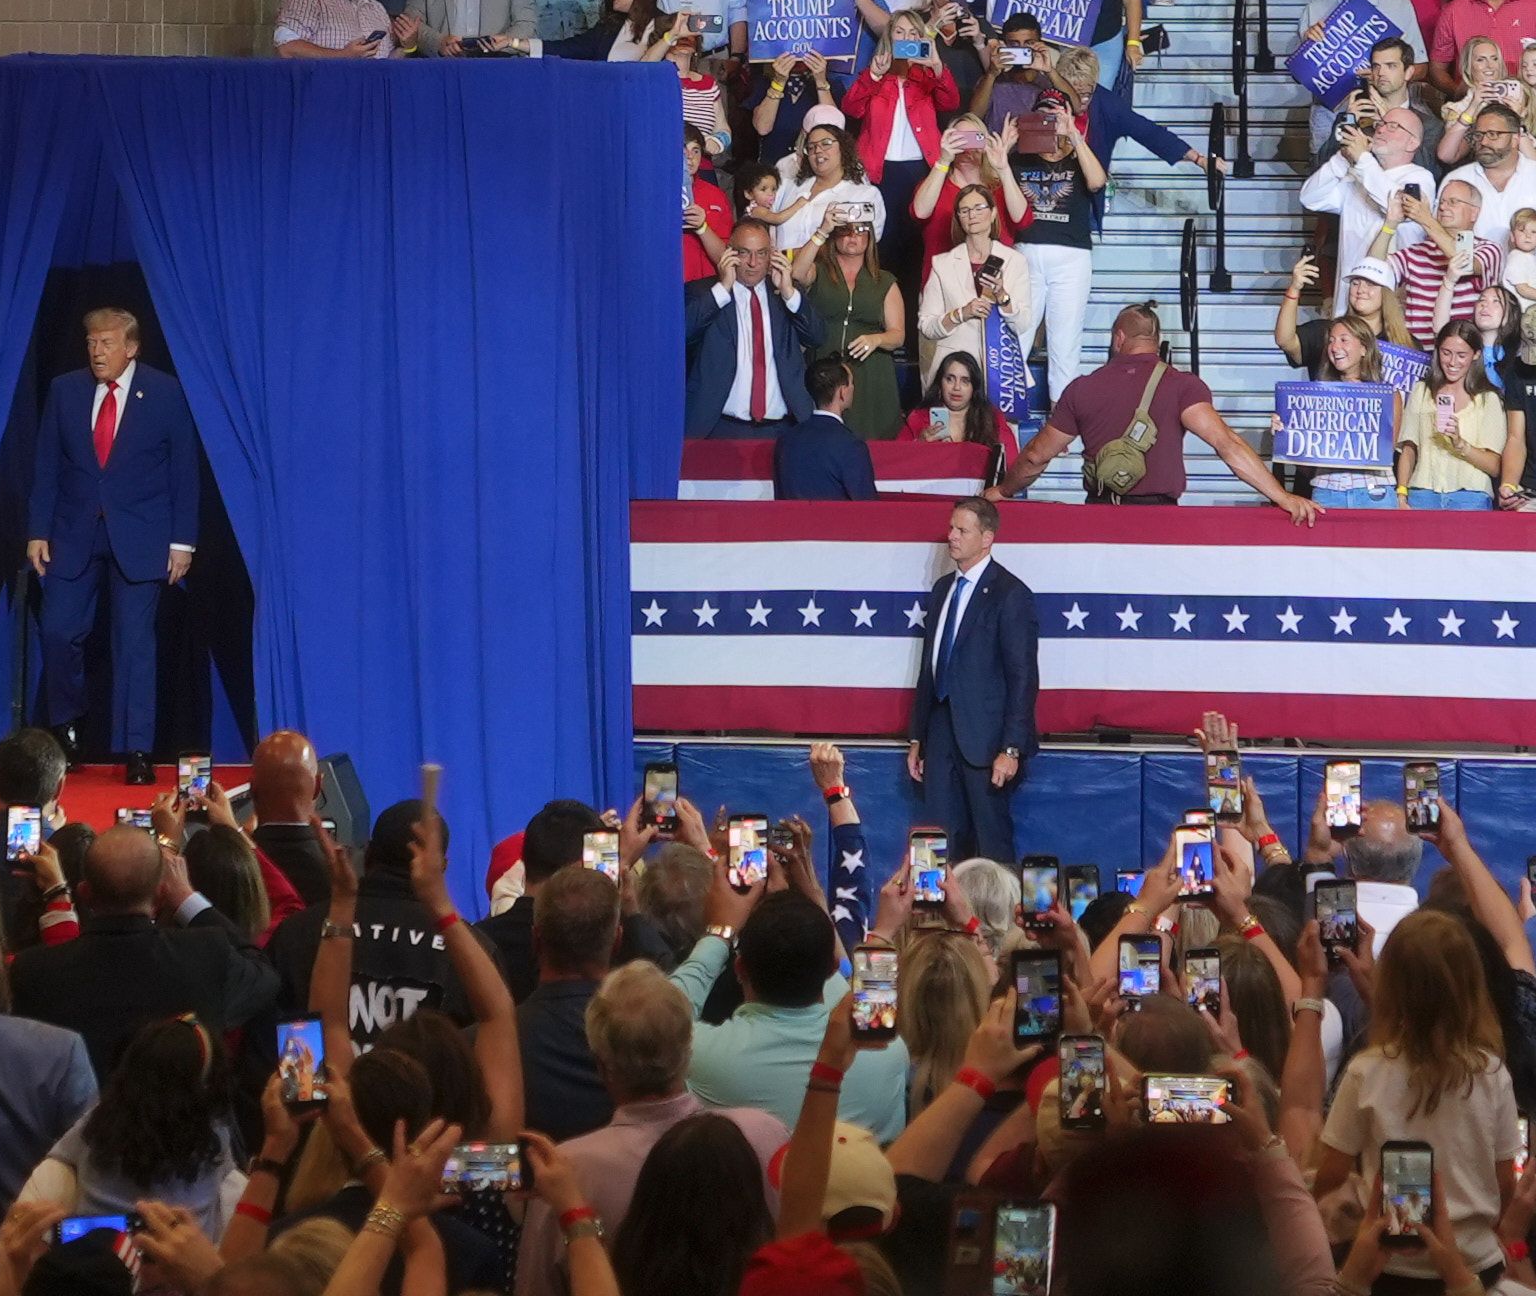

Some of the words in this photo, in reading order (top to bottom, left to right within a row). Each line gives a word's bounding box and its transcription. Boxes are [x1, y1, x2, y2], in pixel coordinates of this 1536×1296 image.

[754, 16, 851, 42] ACCOUNTS
[1003, 0, 1087, 43] DEAM
[1304, 11, 1359, 65] TRUMP
[1312, 15, 1388, 95] ACCOUNTS
[999, 315, 1015, 413] CCOUNTS
[1286, 394, 1353, 411] POWERING
[1356, 396, 1382, 413] THE
[1287, 410, 1381, 434] AMERICAN
[1285, 430, 1380, 462] DREAM
[352, 922, 447, 951] TIVE
[349, 981, 429, 1034] NOT
